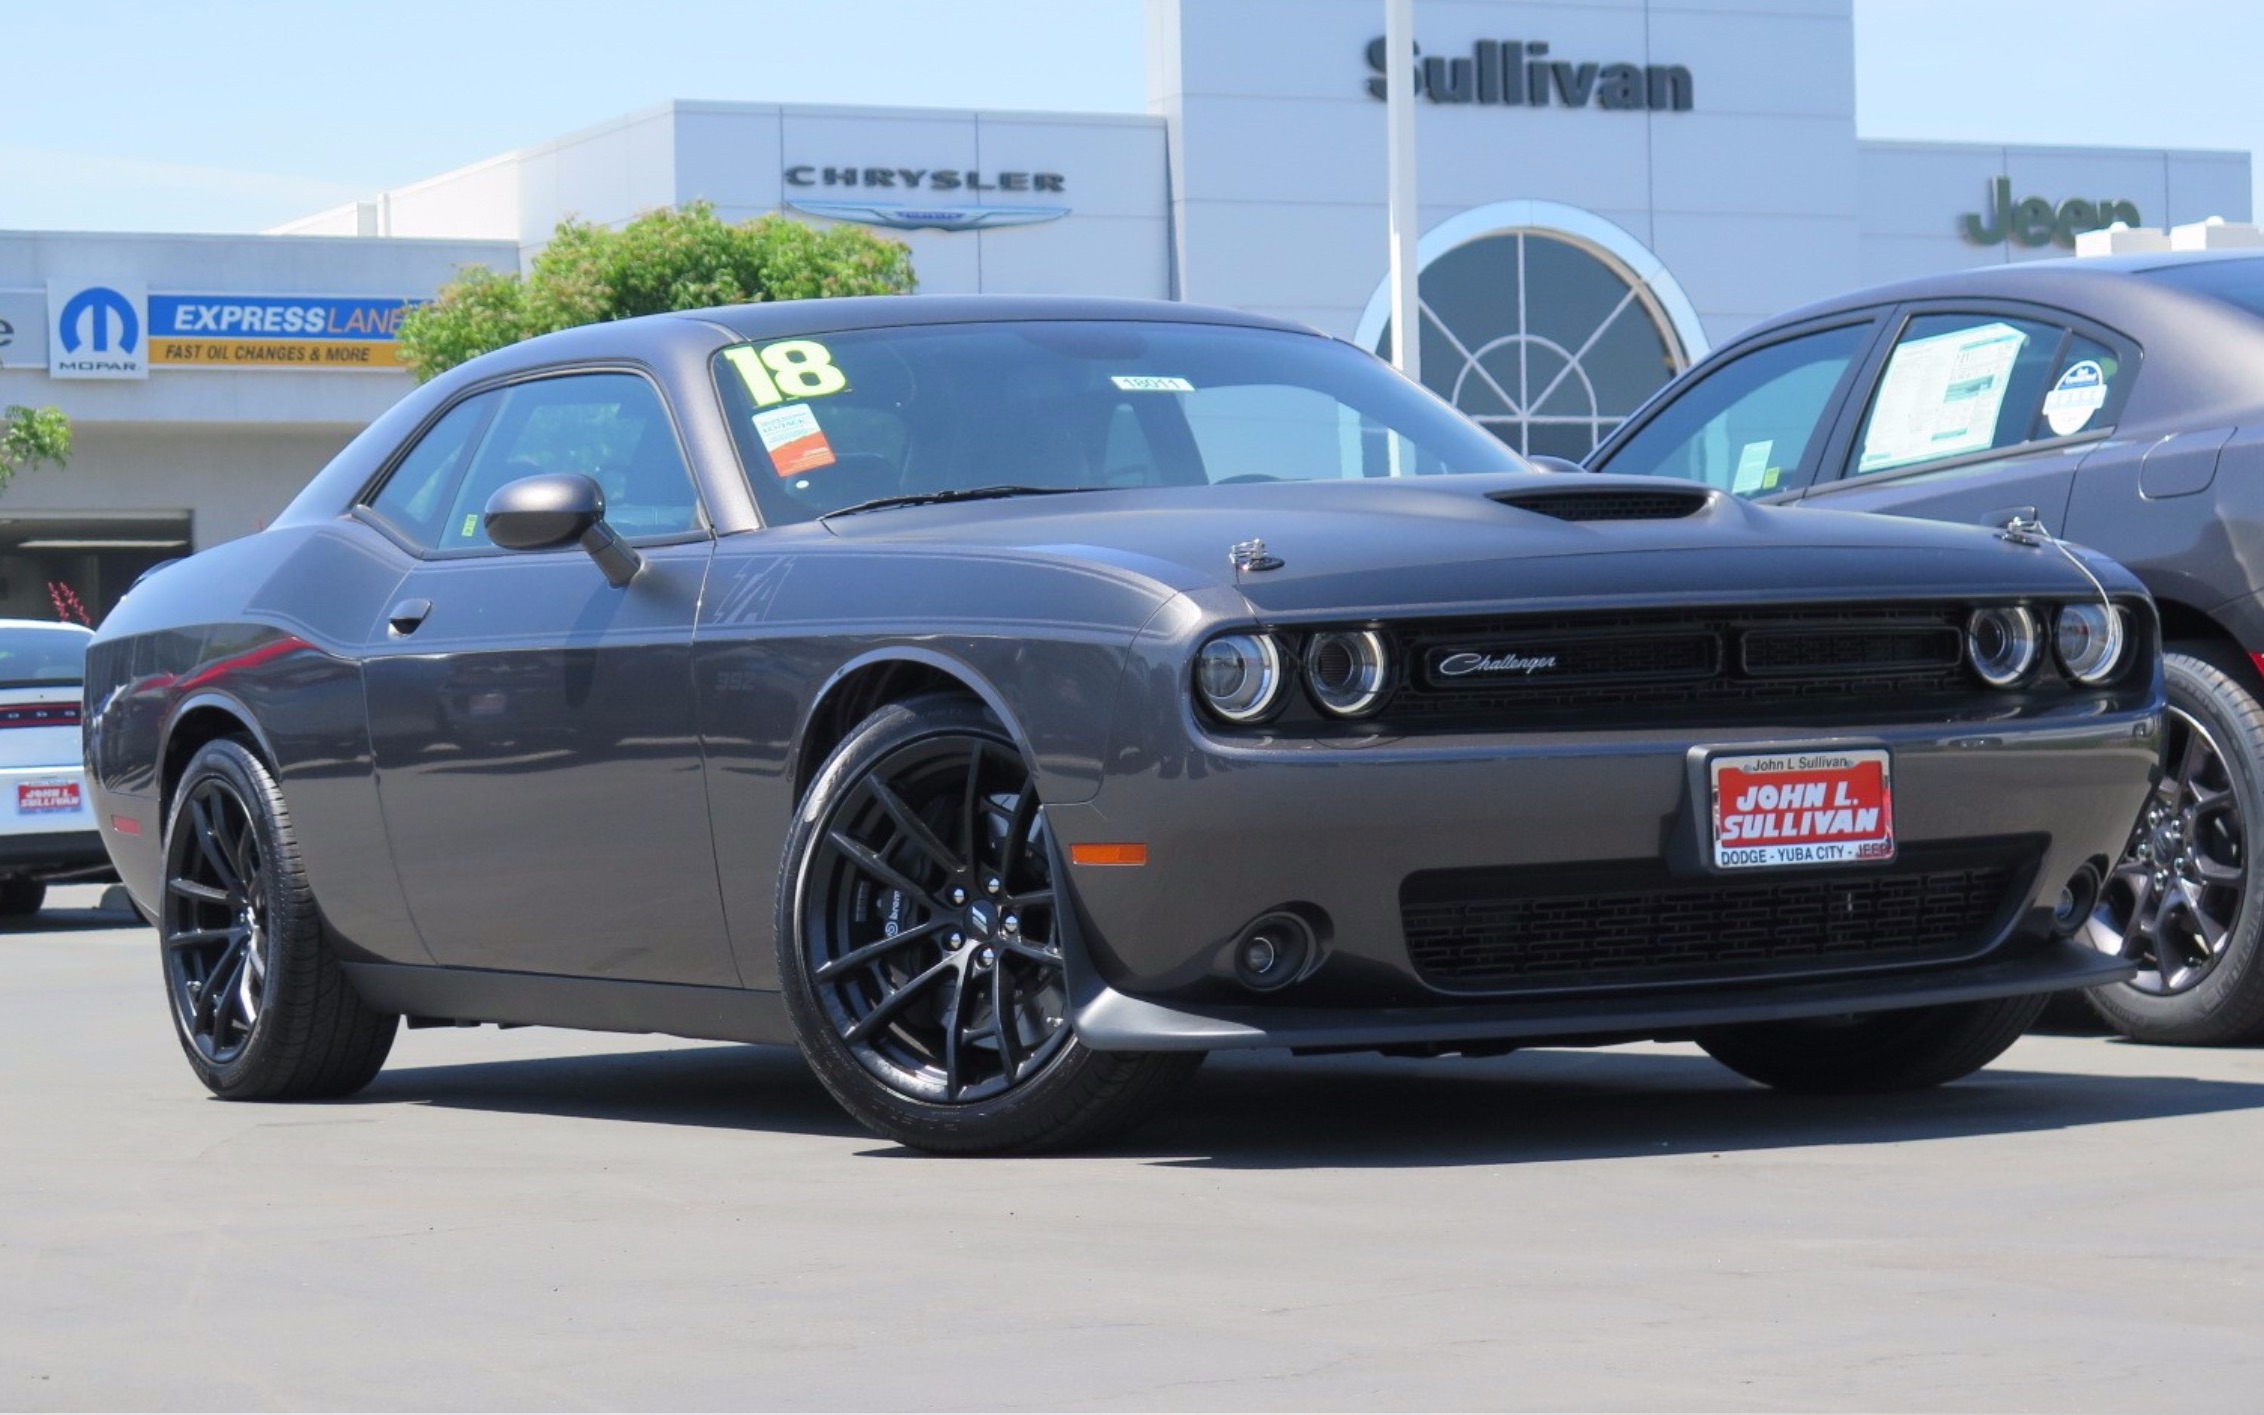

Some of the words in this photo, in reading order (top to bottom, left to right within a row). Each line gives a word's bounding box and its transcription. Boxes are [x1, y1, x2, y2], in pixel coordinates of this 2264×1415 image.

[1365, 34, 1694, 112] Sullivan
[784, 165, 1067, 192] CHRYSLER
[165, 344, 202, 360] FAST
[206, 345, 229, 360] OIL
[234, 346, 305, 361] CHANGES
[309, 347, 321, 361] &
[325, 347, 370, 362] MORE
[58, 361, 138, 371] MOPAR
[723, 340, 846, 407] 18
[1440, 653, 1556, 675] Challenger
[1752, 758, 1784, 772] John
[1787, 757, 1795, 769] L
[1799, 756, 1848, 769] Sullivan
[1736, 782, 1827, 812] JOHN
[1834, 781, 1859, 807] L.
[1721, 807, 1879, 841] SULLIVAN
[1721, 849, 1767, 866] DODGE
[1777, 847, 1813, 862] YUBA
[1813, 845, 1844, 860] CITY
